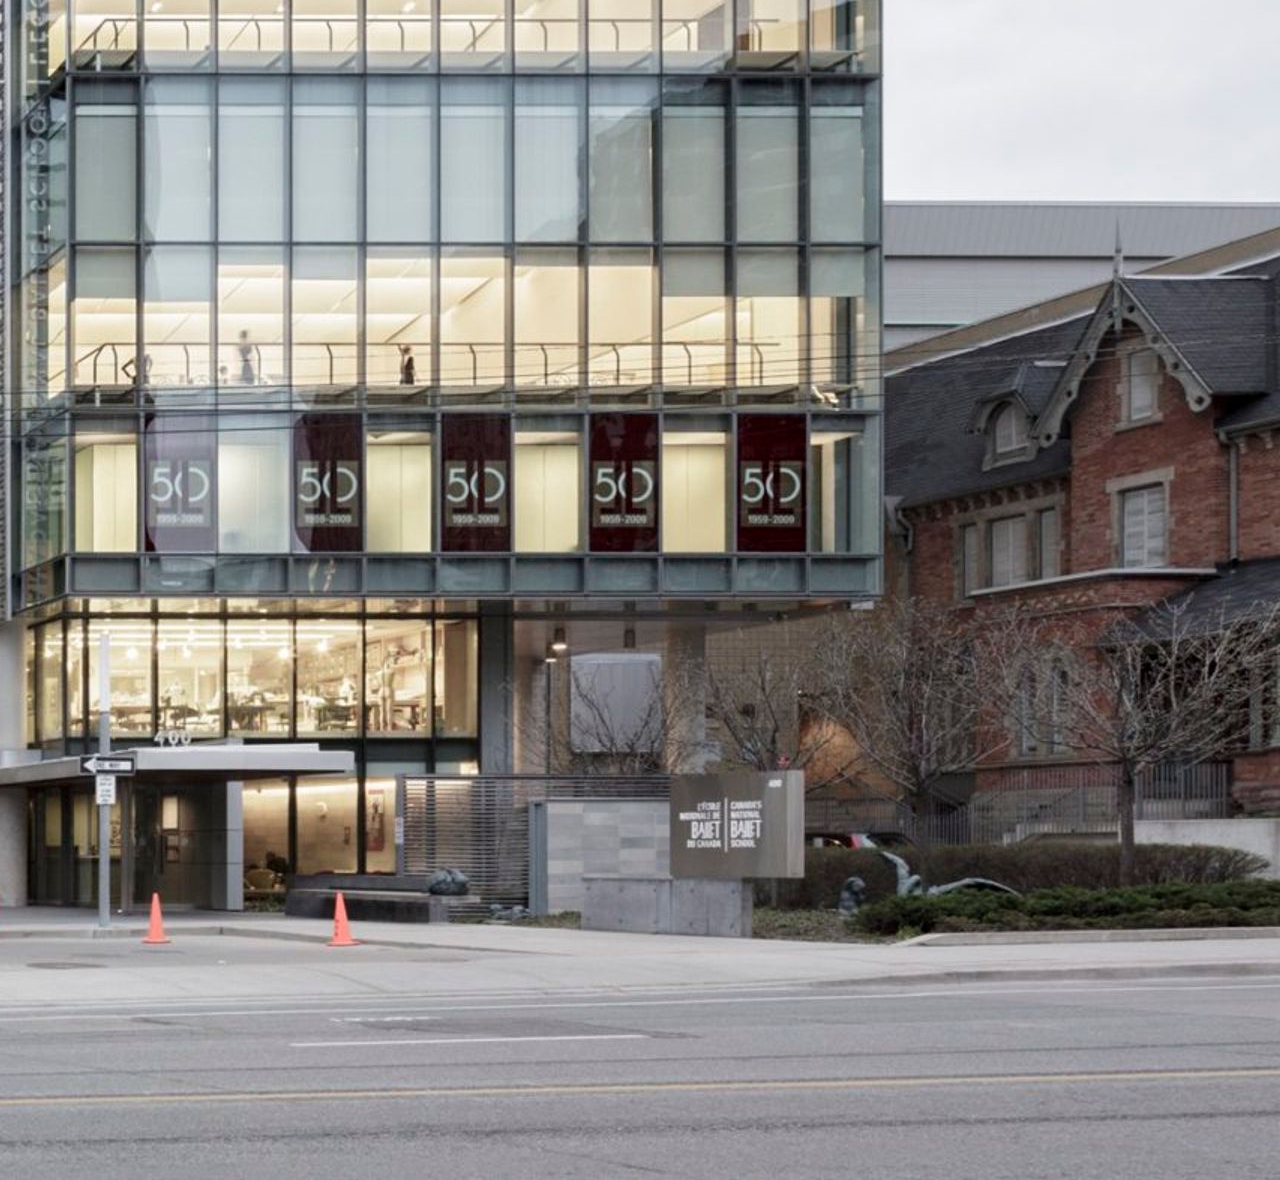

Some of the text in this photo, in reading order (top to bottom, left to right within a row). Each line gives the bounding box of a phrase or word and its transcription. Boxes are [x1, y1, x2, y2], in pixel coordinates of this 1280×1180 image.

[151, 467, 210, 502] 50
[299, 467, 358, 502] 50
[446, 467, 505, 502] 50
[594, 467, 653, 502] 50
[742, 467, 801, 502] 50
[154, 729, 191, 747] 400
